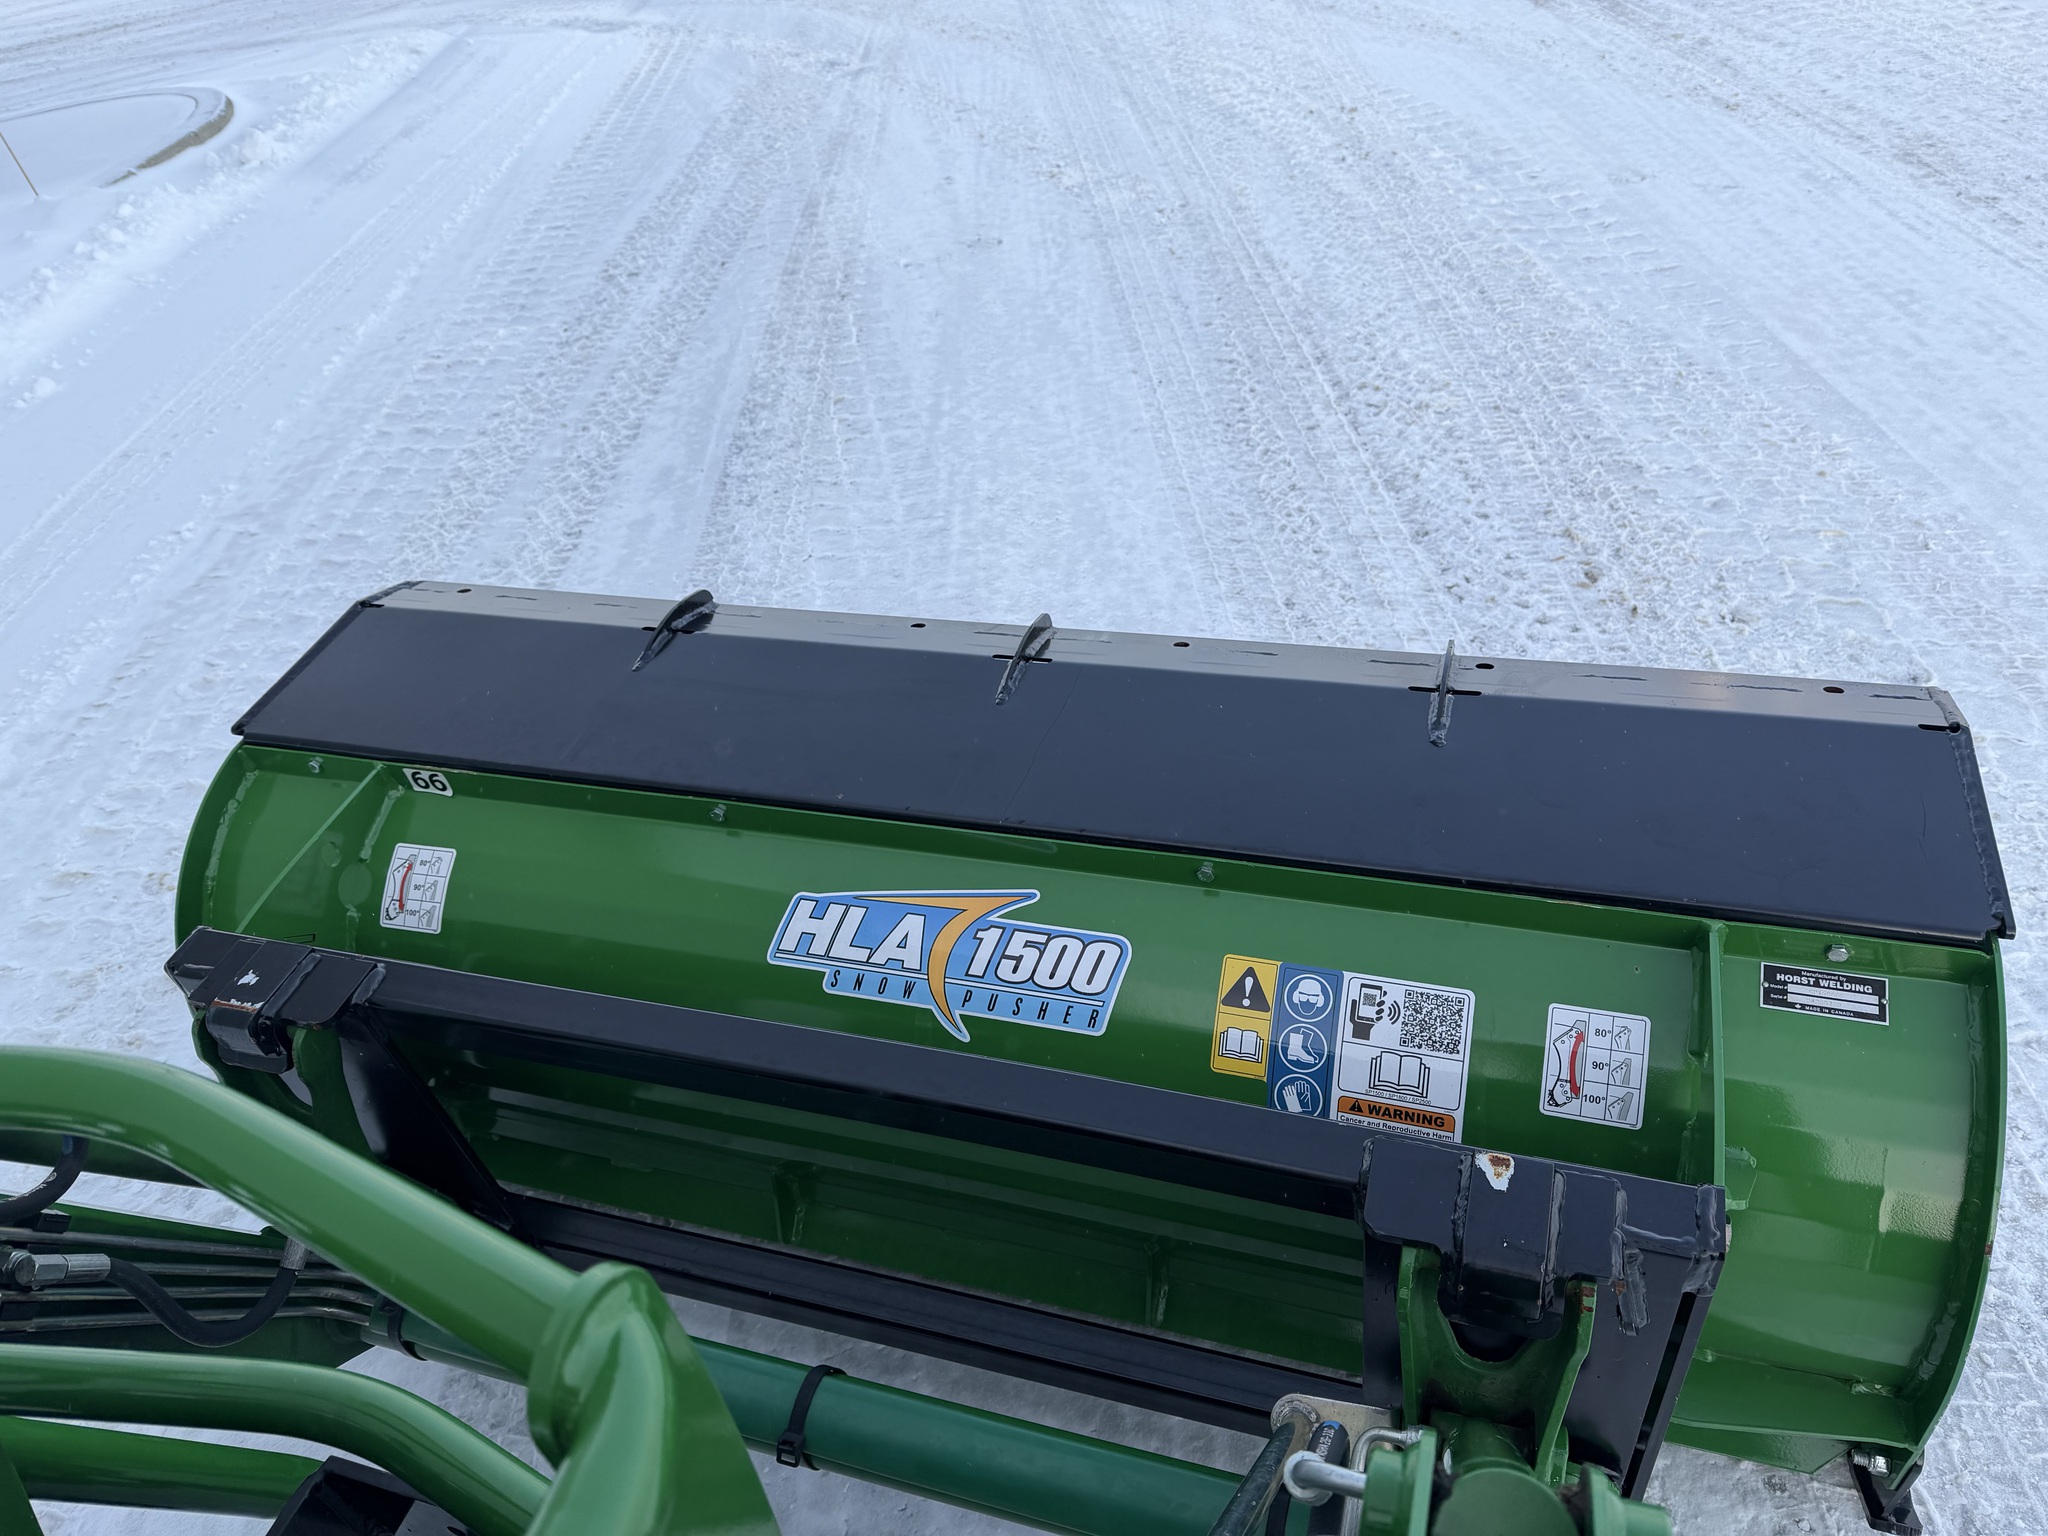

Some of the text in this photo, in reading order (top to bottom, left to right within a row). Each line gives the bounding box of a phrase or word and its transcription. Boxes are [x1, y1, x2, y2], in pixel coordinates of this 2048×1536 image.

[411, 771, 448, 792] 66
[776, 899, 1122, 995] HLA 1500
[1776, 973, 1873, 993] HORST WELDING
[1801, 971, 1839, 980] Manufactured
[830, 970, 1101, 1029] SNOW PUSHER
[1831, 1009, 1854, 1017] CANADA
[1594, 1028, 1611, 1037] 80°
[1592, 1061, 1609, 1070] 90°
[1583, 1094, 1606, 1104] 100°
[1367, 1103, 1445, 1128] WARNING
[1340, 1115, 1365, 1124] Cancer
[1382, 1122, 1430, 1137] Reproductive
[1432, 1132, 1452, 1141] Harm
